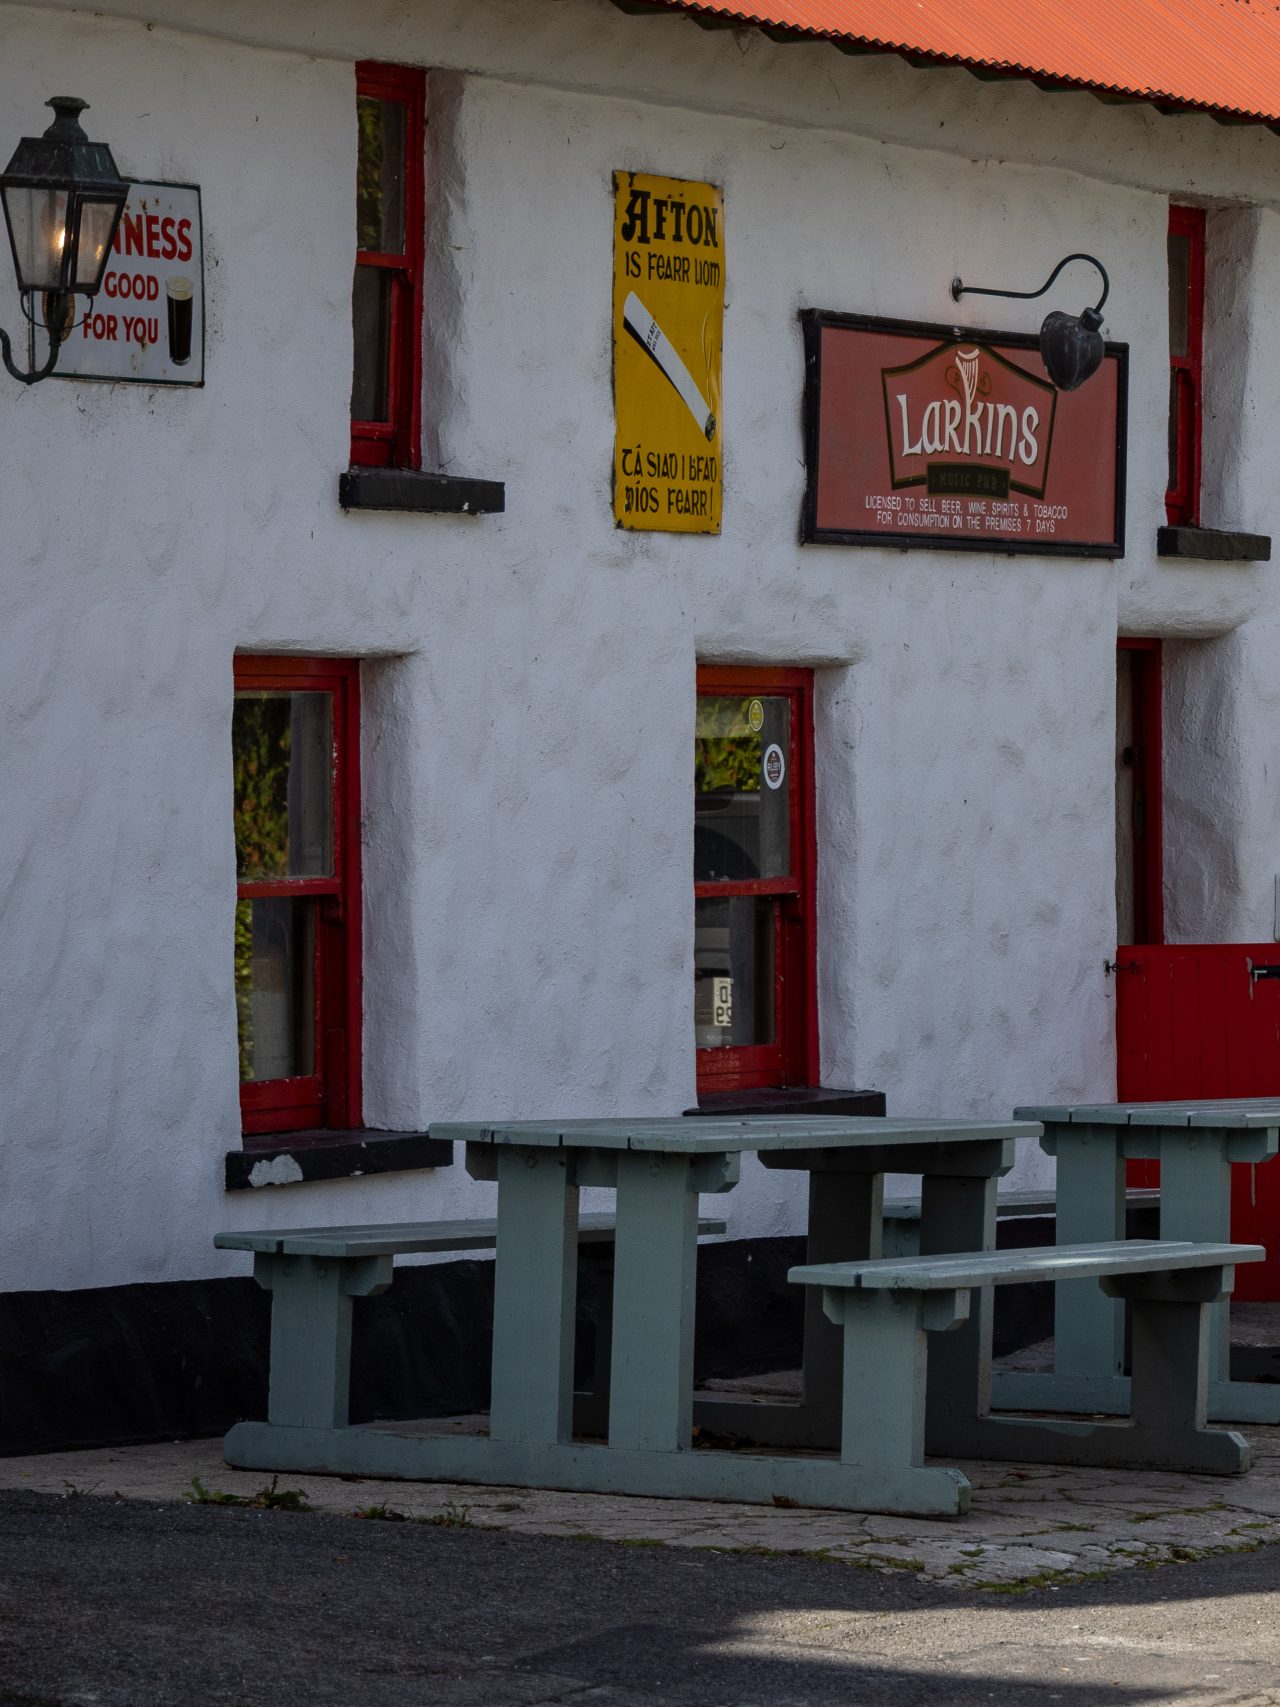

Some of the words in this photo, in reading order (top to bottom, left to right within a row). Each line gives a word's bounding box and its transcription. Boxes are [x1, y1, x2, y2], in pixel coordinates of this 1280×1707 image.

[621, 189, 718, 248] AFTON
[104, 271, 159, 301] GOOD
[83, 312, 118, 341] FOR
[122, 315, 158, 344] YOU
[938, 473, 971, 488] MUSIC
[977, 473, 997, 490] PUB
[865, 495, 902, 511] LICENSED
[905, 498, 915, 511] TO
[920, 499, 936, 512] SELL
[991, 502, 1019, 516] SPIRITS
[1023, 503, 1028, 517] &
[1033, 504, 1068, 519] TOBACCO
[877, 511, 892, 525] FOR
[898, 512, 949, 528] CONSUMPTION
[953, 515, 962, 529] ON
[967, 516, 980, 530] THE
[985, 516, 1021, 532] PREMISES
[1026, 519, 1031, 532] 7
[1036, 520, 1055, 533] DAYS
